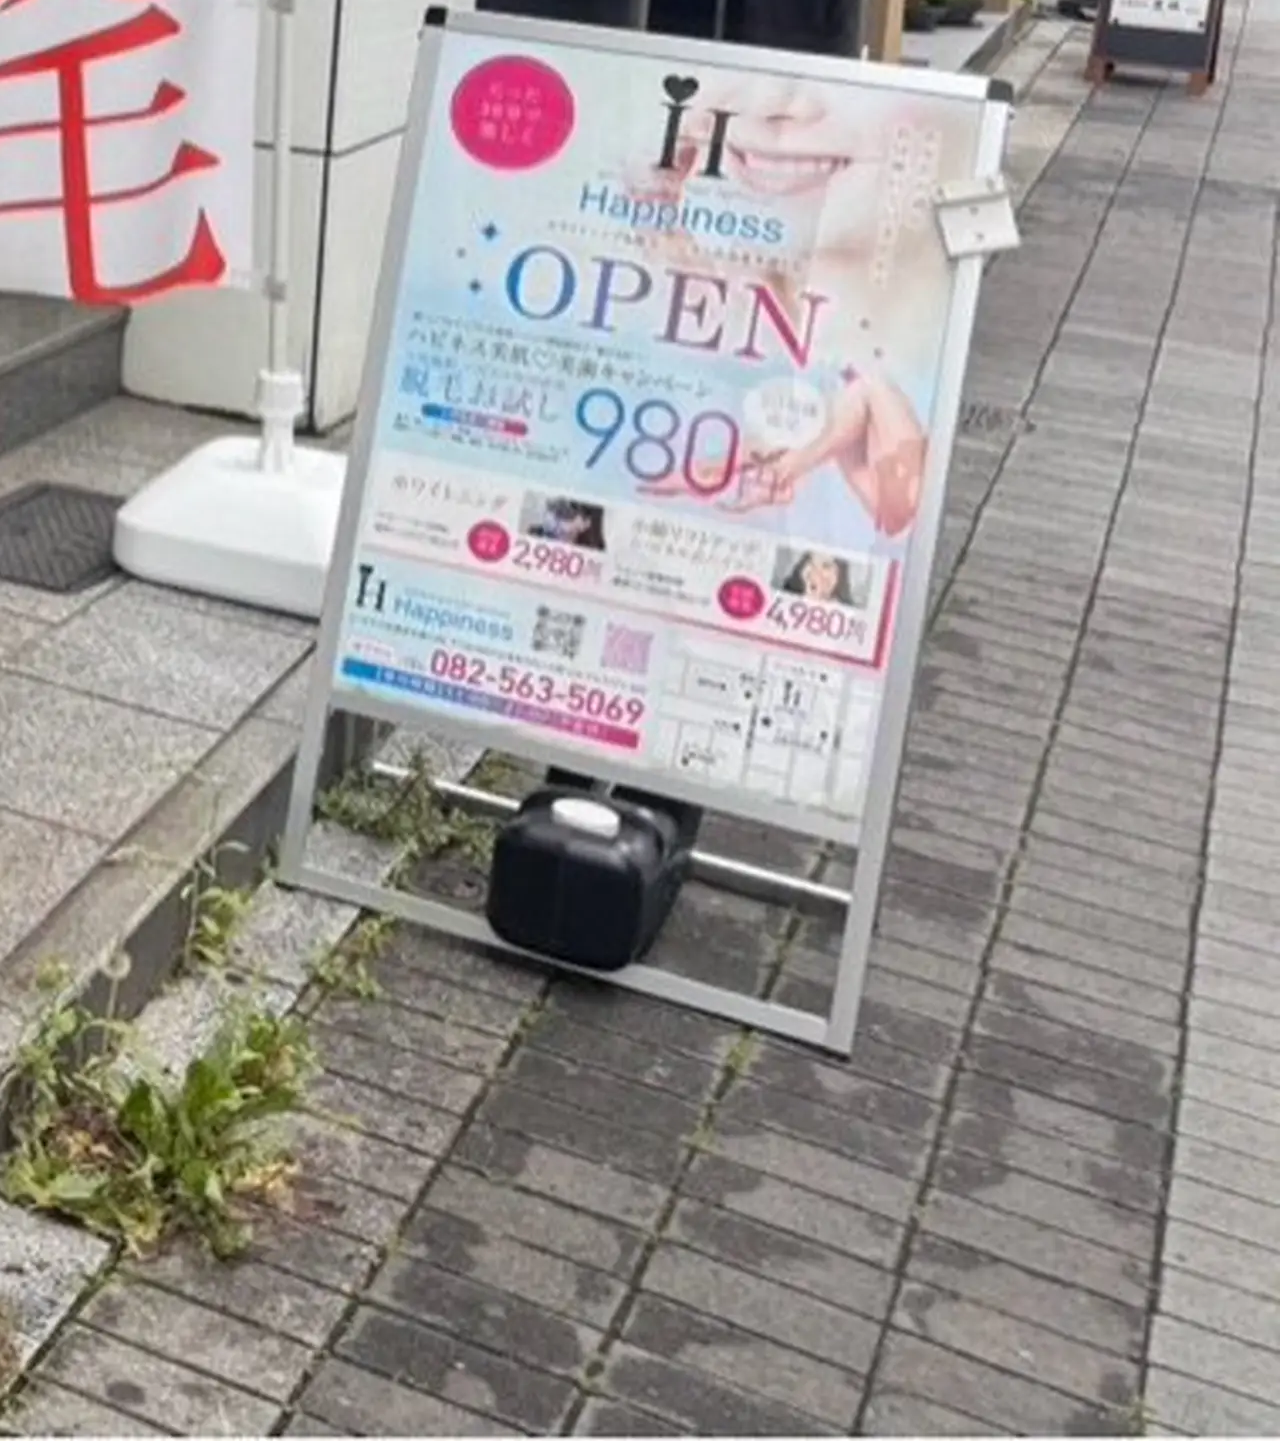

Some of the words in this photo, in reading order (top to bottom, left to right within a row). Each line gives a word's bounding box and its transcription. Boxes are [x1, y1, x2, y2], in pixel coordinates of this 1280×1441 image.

[579, 182, 785, 245] Happiness
[505, 245, 828, 369] OPEN
[393, 597, 514, 641] Happiness
[430, 649, 645, 726] 082-563-5069
